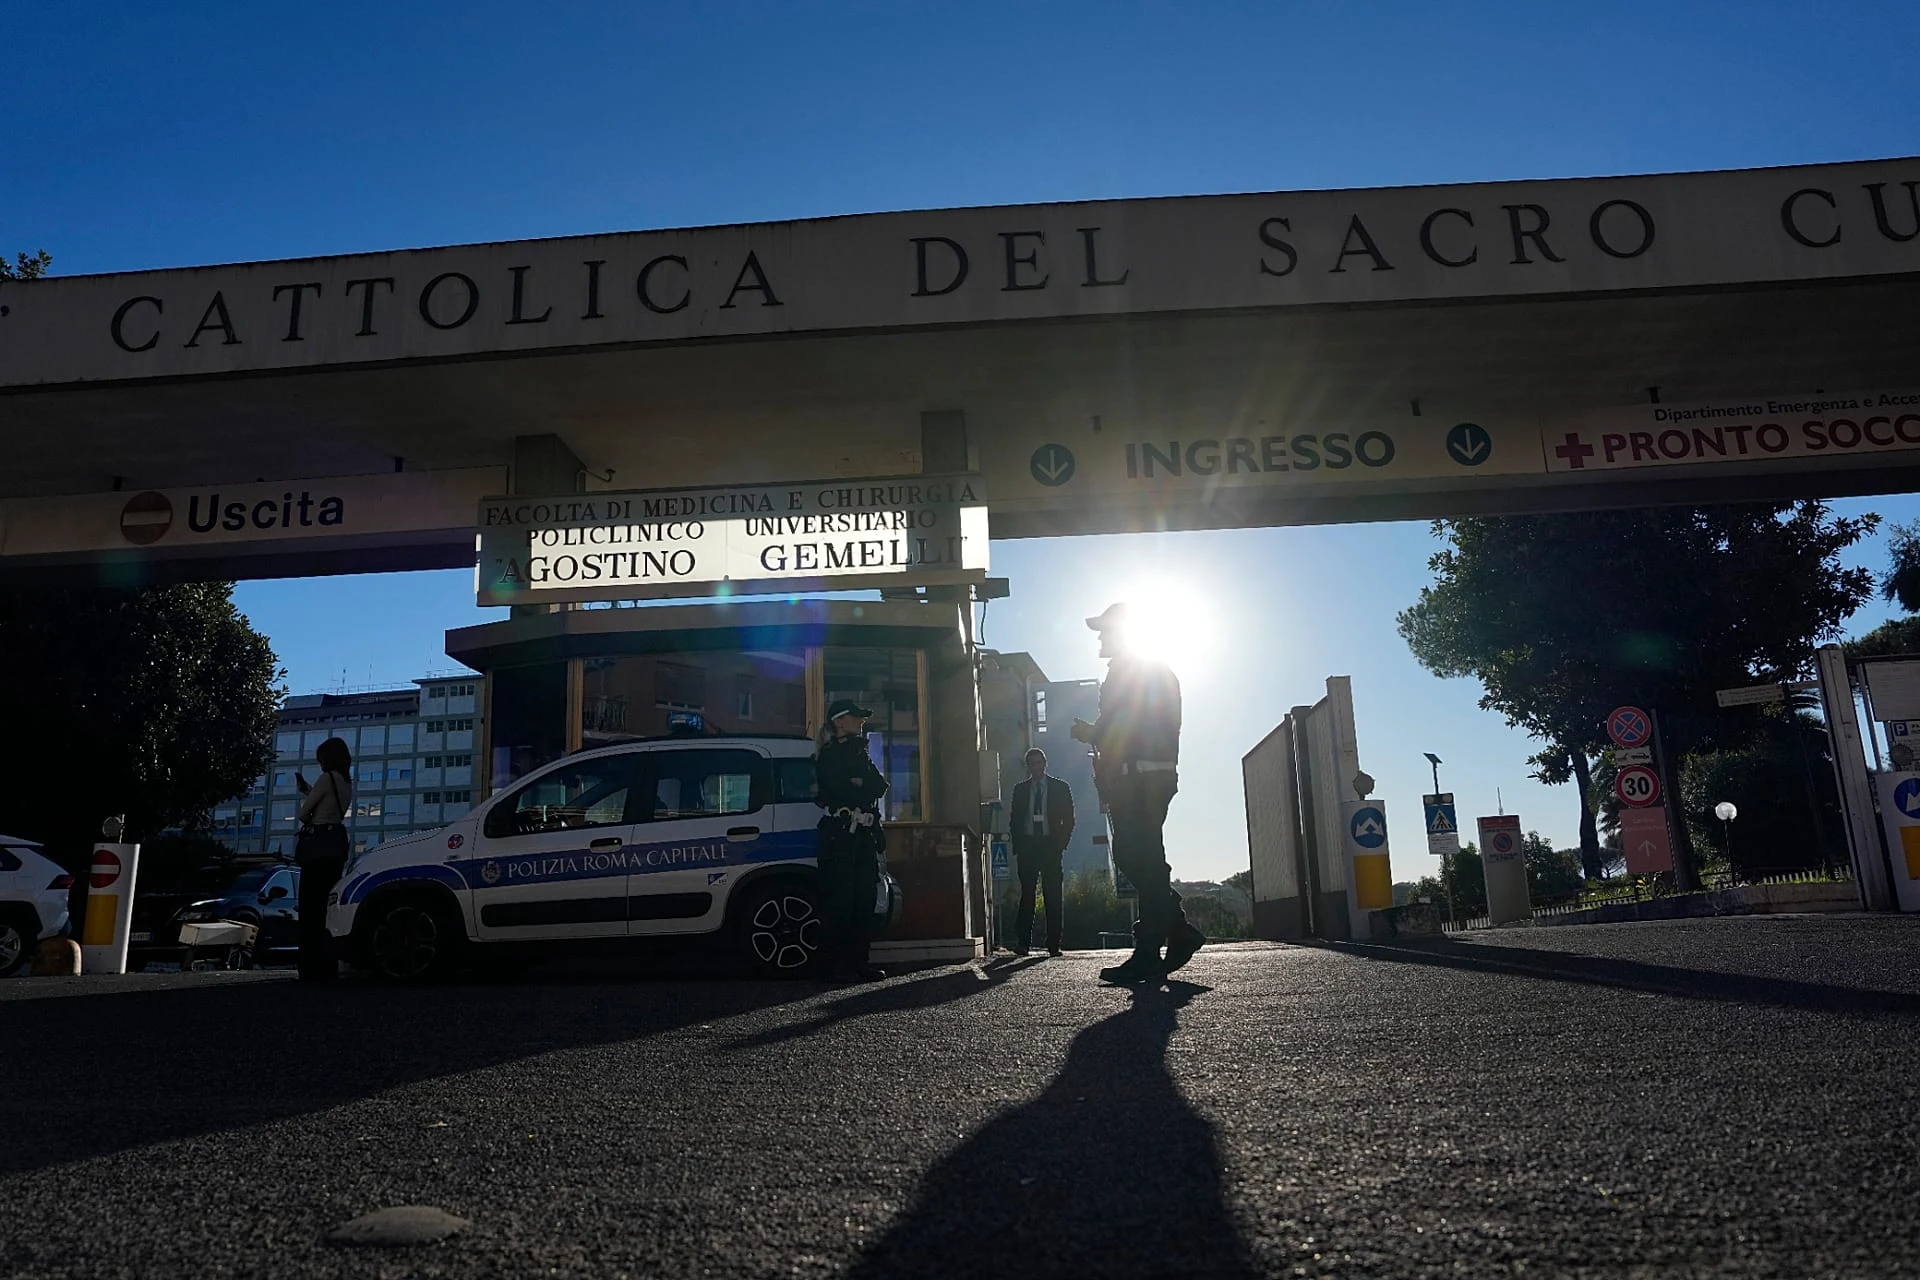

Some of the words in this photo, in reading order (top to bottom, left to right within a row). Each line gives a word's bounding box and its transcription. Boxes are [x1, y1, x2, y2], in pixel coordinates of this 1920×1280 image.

[110, 250, 784, 353] CATTOLICA
[910, 227, 1130, 298] DEL
[1259, 199, 1656, 277] SACRO
[1781, 181, 1920, 248] CU
[1653, 403, 1763, 423] Dipartimento
[1768, 397, 1859, 415] Emergenza
[1863, 396, 1873, 407] e
[1879, 392, 1920, 407] Acce
[1124, 430, 1396, 479] INGRESSO
[1602, 423, 1789, 463] PRONTO
[188, 491, 344, 533] Uscita
[605, 499, 632, 520] DI
[643, 493, 774, 518] MEDICINA
[788, 489, 804, 510] E
[818, 484, 978, 508] CHIRURGIA
[527, 521, 705, 547] POLICLINICO
[745, 510, 936, 537] UNIVERSITARIO
[1625, 776, 1650, 796] 30
[508, 858, 578, 878] POLIZIA
[584, 852, 643, 872] ROMA
[646, 843, 728, 866] CAPITALE
